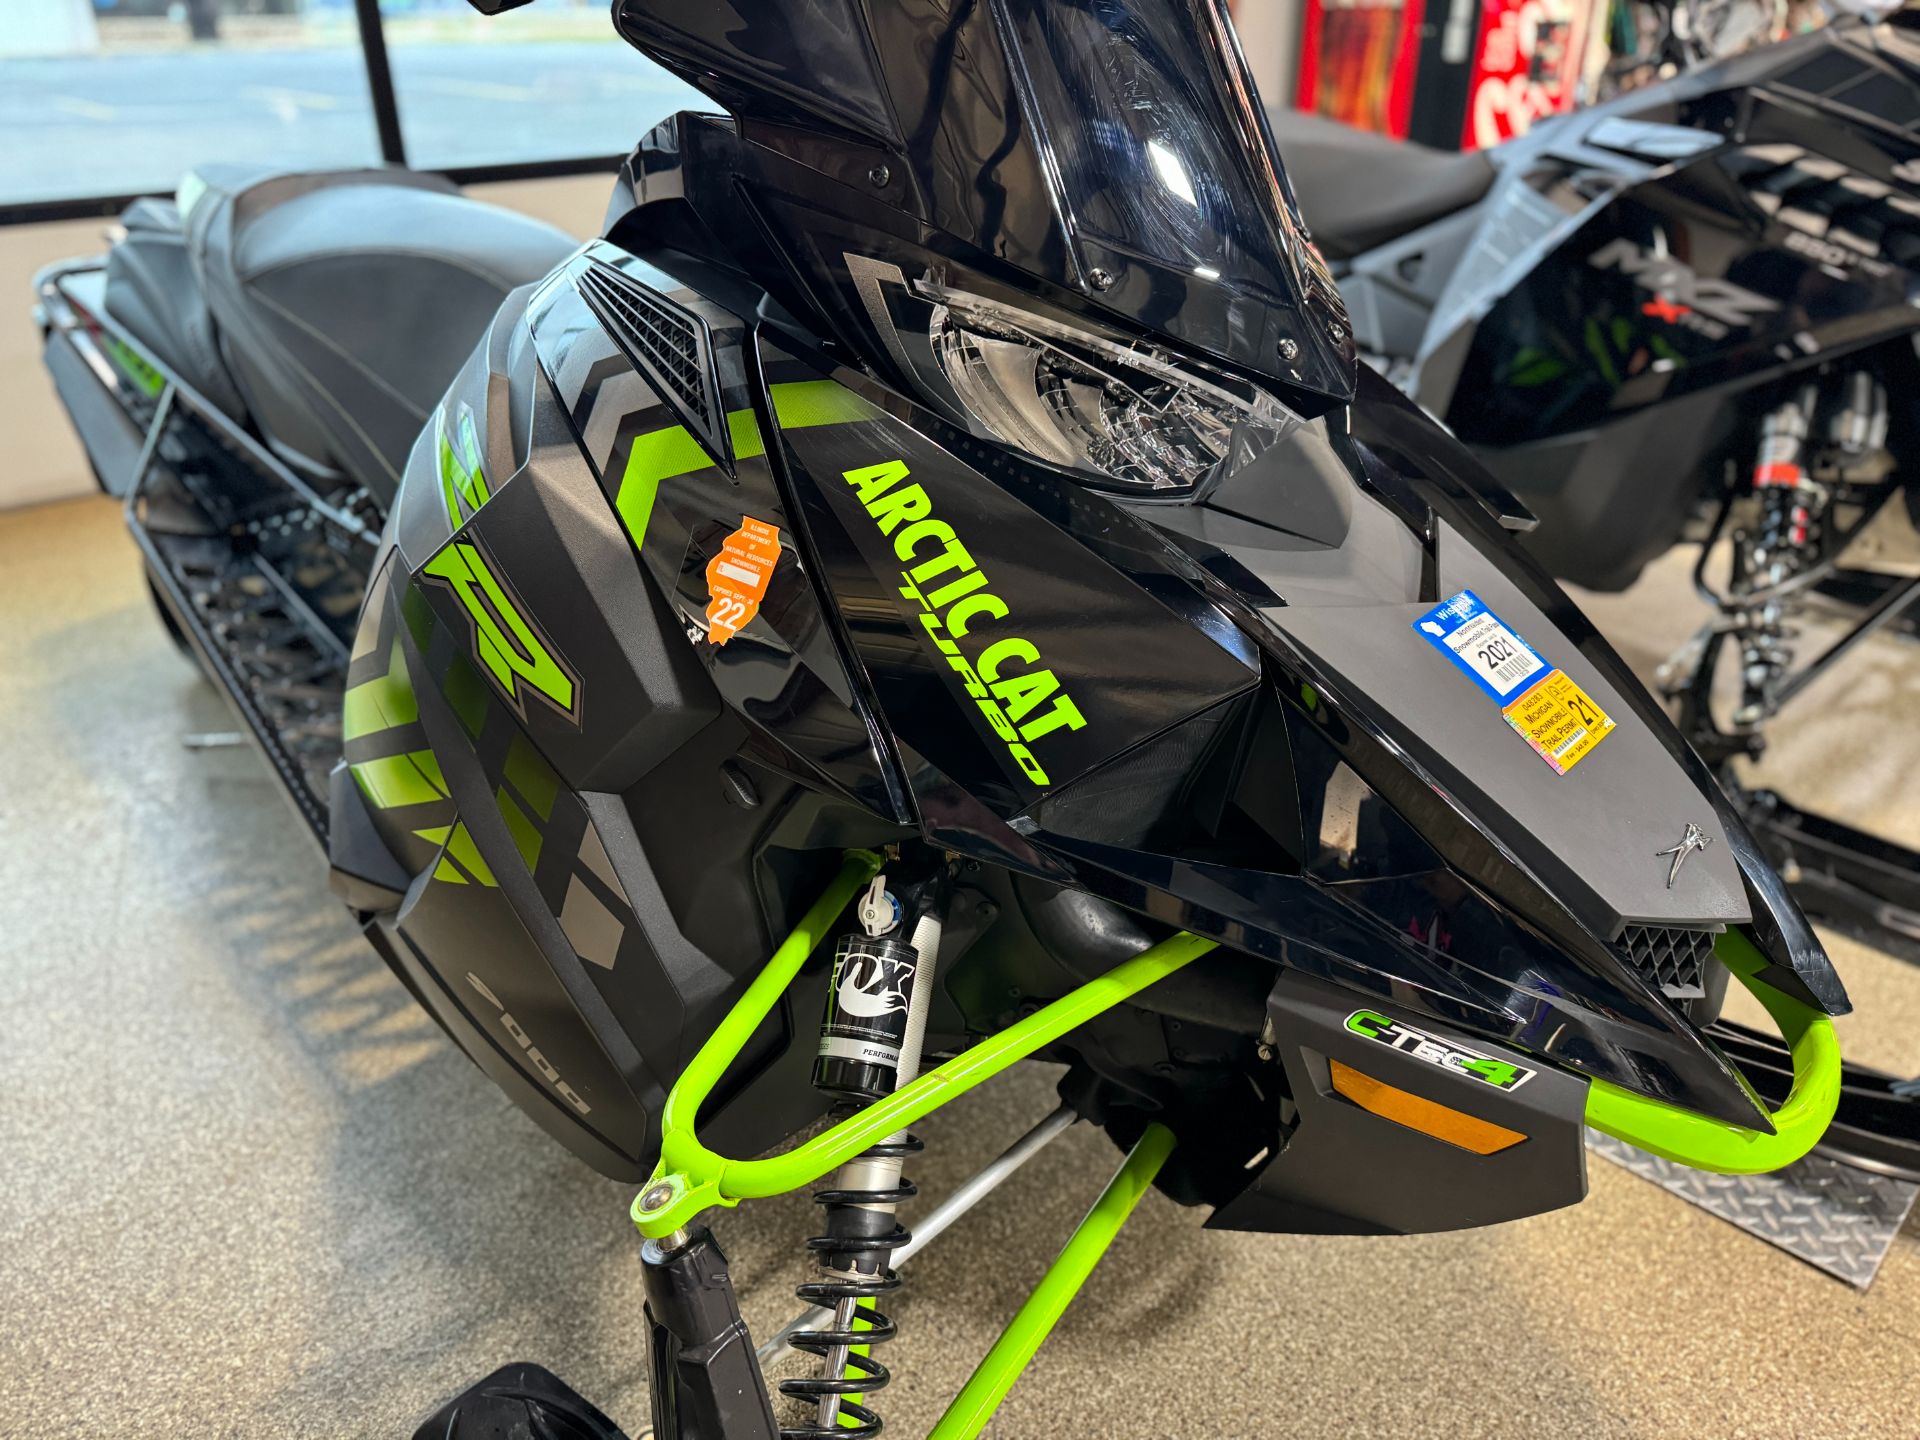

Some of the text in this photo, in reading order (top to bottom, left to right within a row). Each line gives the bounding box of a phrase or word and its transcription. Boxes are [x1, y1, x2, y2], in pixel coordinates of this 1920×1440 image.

[725, 545, 747, 558] NATURAL
[741, 530, 772, 546] DEPARTMENT
[711, 597, 746, 631] 22
[842, 459, 1087, 742] ARCTIC CAT
[1478, 636, 1518, 670] 2021
[898, 571, 1050, 786] TURBO
[1567, 694, 1599, 726] 21
[828, 953, 915, 997] FOX
